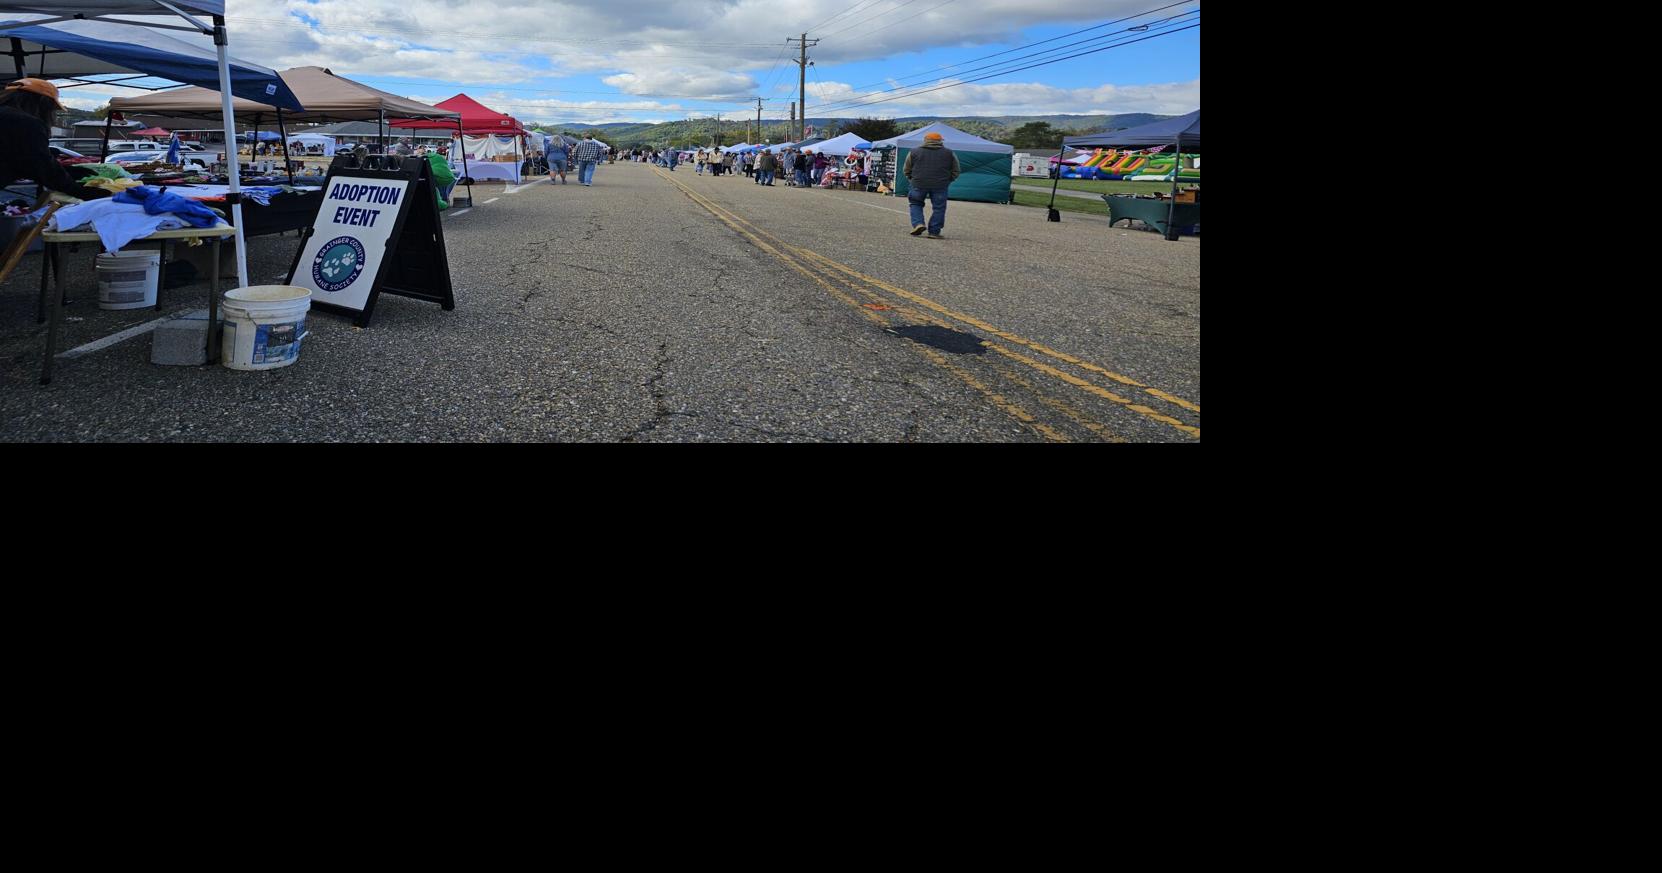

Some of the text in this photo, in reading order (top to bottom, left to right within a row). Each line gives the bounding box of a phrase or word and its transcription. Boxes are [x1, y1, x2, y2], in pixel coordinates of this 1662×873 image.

[329, 183, 401, 205] ADOPTION
[333, 206, 381, 227] EVENT
[320, 237, 363, 262] GRAINGER COUNTY
[314, 264, 357, 290] HUMANE SOCIETY
